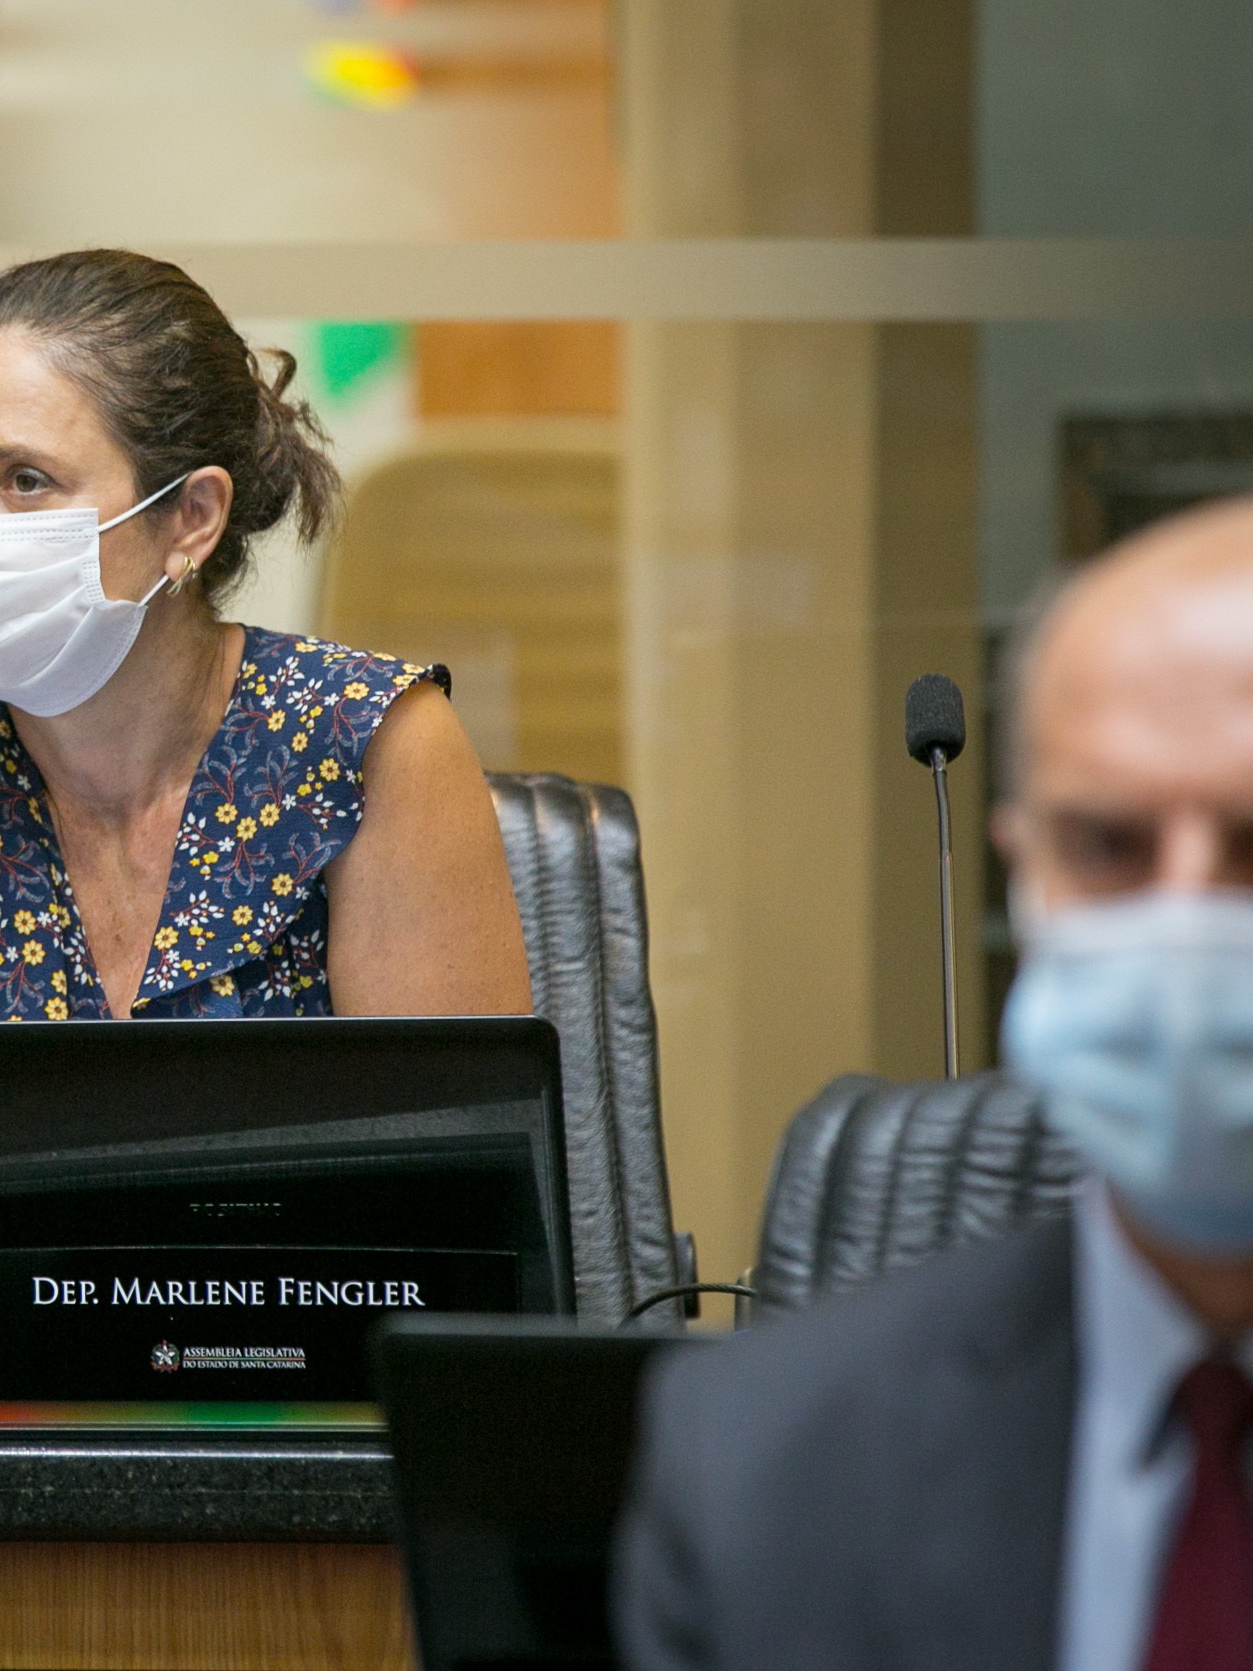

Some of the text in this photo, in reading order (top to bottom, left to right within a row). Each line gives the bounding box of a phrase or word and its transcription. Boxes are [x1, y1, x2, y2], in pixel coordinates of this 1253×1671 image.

[32, 1276, 426, 1307] DEP. MARLENE FENGLER
[183, 1346, 306, 1358] ASSEMBLEIA LEGISLATIVA
[183, 1360, 306, 1369] DO ESTADO DE SANTA CATARINA
